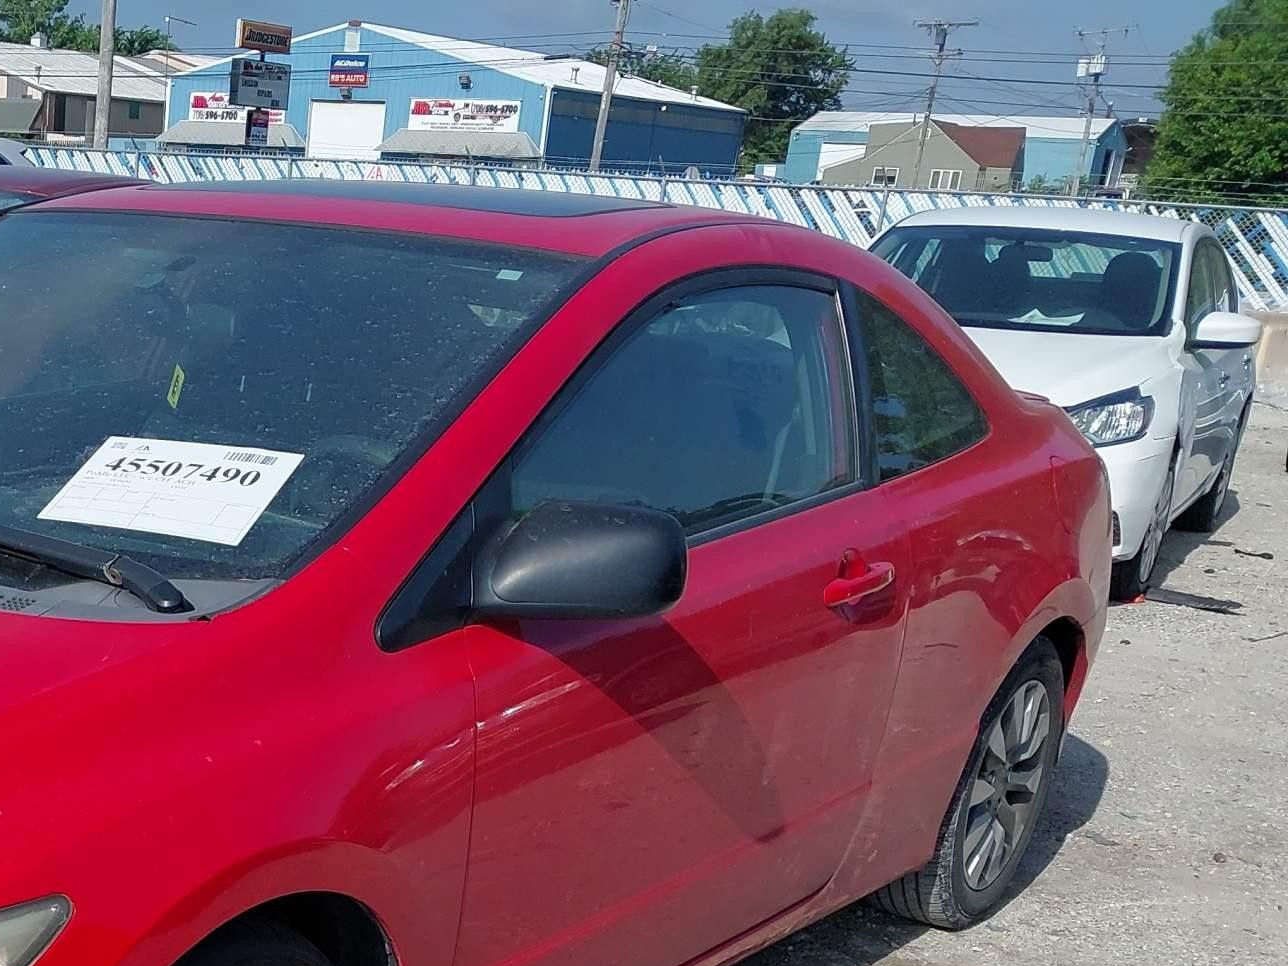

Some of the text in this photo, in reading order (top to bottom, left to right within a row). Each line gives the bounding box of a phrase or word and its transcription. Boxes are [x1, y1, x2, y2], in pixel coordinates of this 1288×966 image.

[244, 27, 290, 47] BRIDGESTONE
[345, 74, 365, 82] AUTO
[105, 456, 261, 486] 45507490
